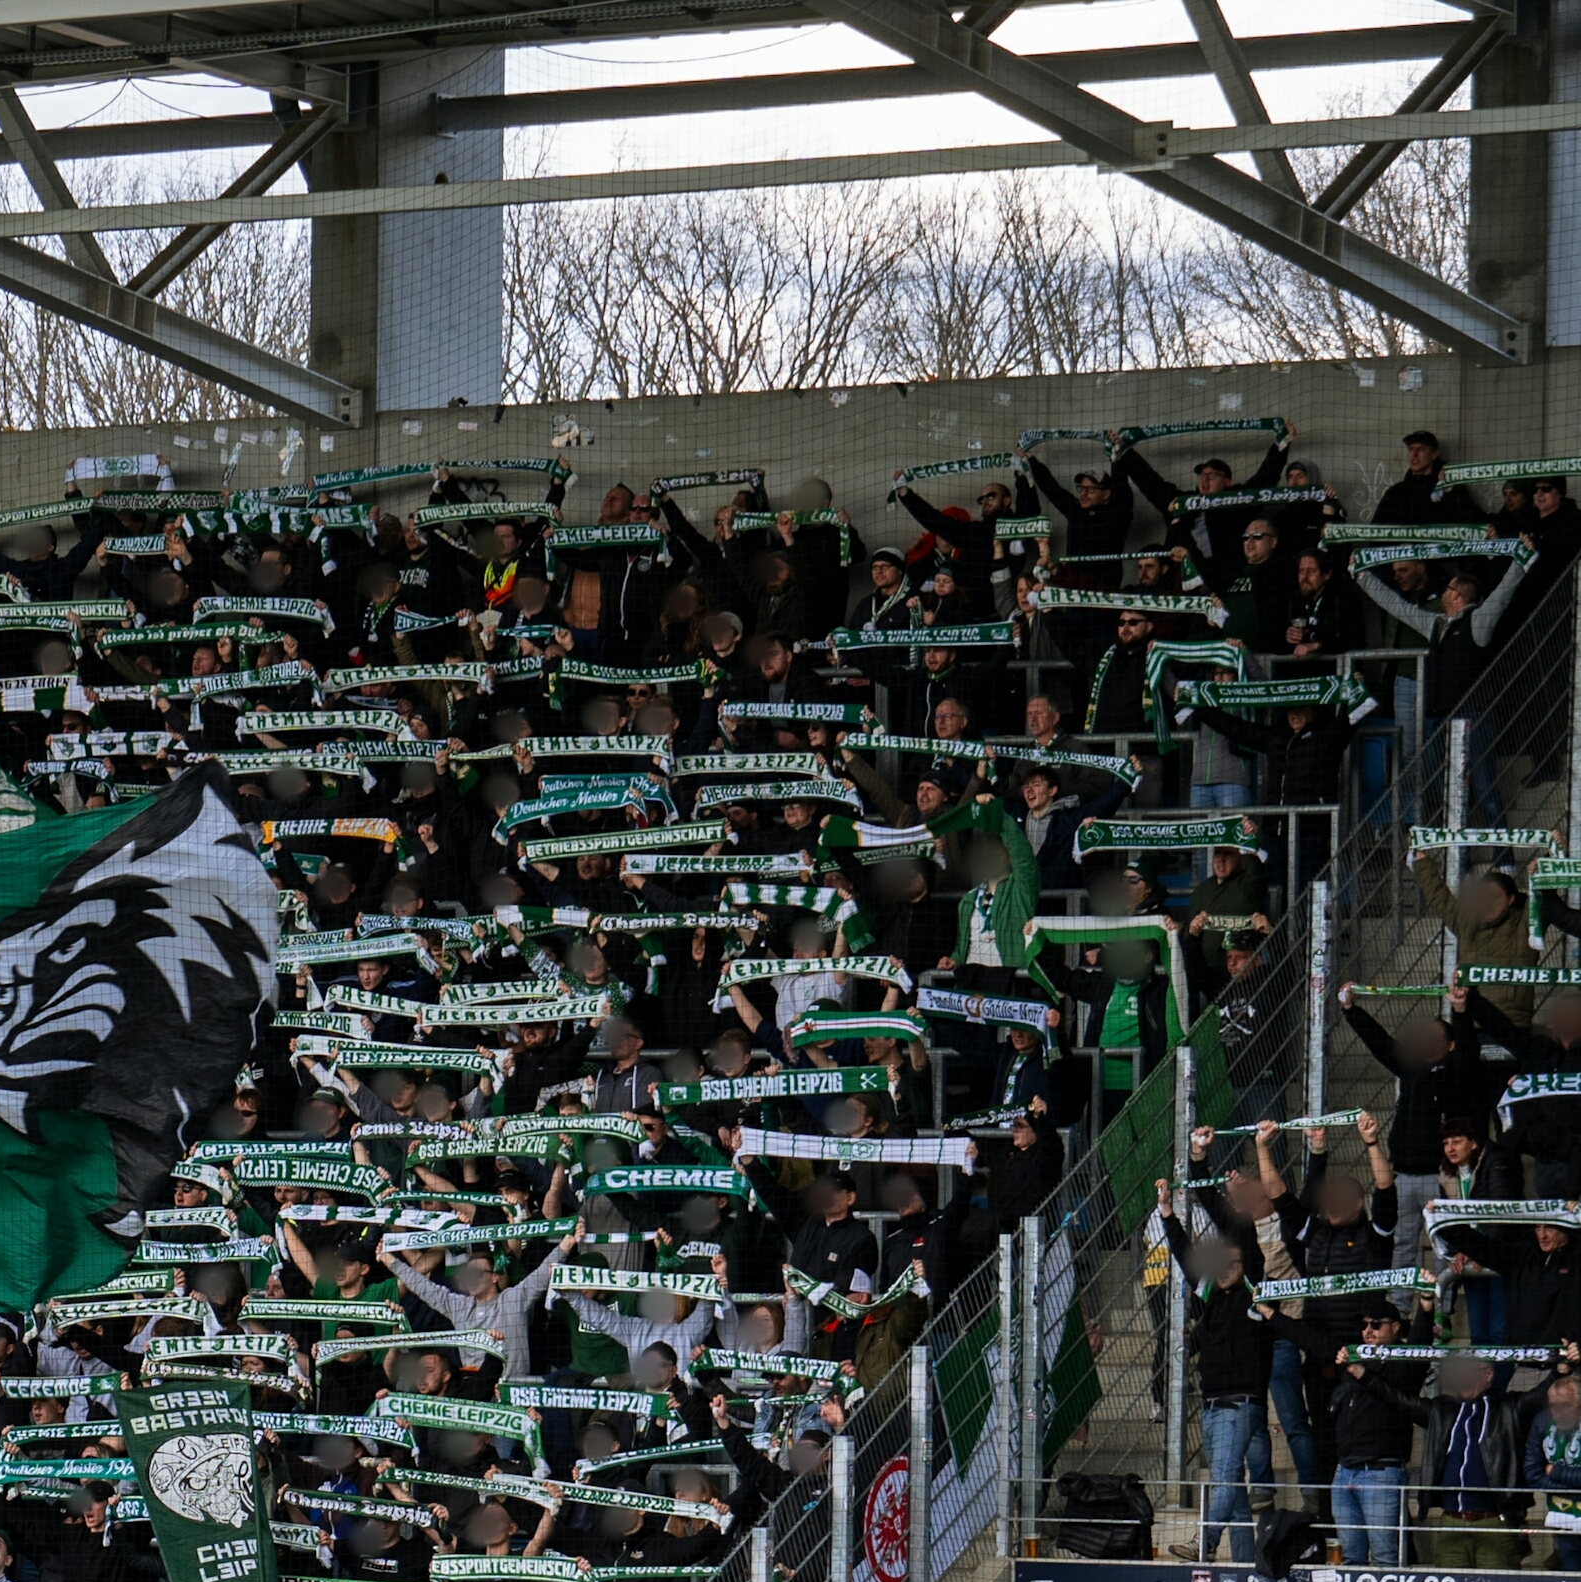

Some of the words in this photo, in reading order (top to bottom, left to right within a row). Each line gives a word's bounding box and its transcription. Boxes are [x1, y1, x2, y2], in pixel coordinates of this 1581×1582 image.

[605, 1168, 735, 1189] CHEMIE
[543, 1387, 594, 1412] CHEMIE
[598, 1391, 653, 1416] LEIPZIG
